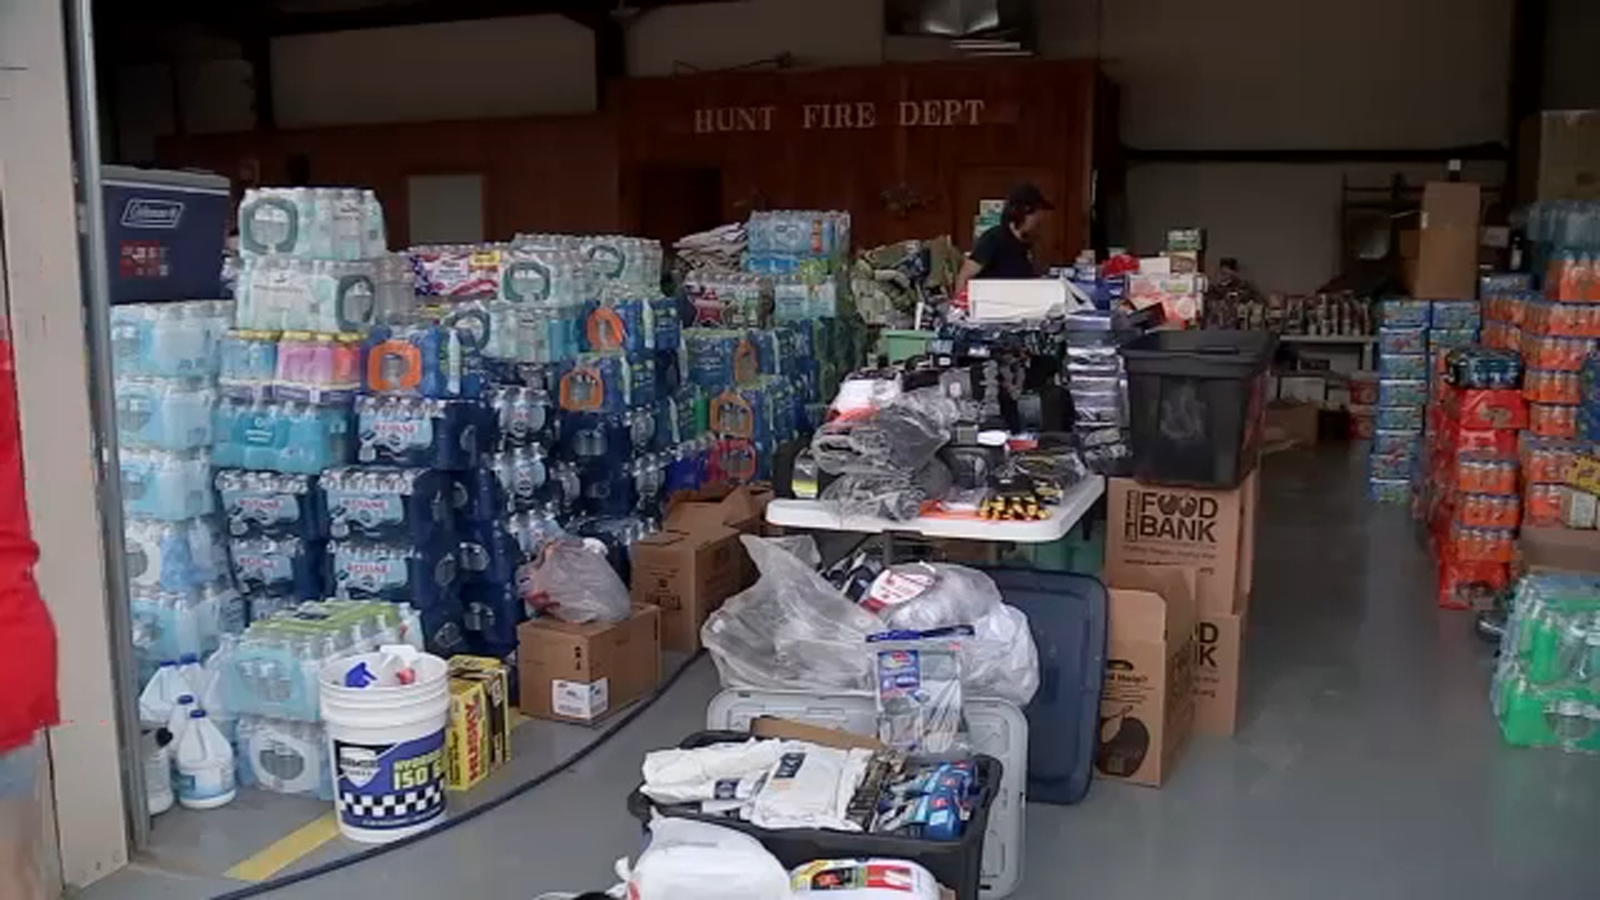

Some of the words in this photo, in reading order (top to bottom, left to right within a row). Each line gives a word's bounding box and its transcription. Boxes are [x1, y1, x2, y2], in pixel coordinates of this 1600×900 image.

[694, 106, 776, 133] HUNT
[803, 103, 876, 129] FIRE
[899, 100, 985, 126] DEPT
[1141, 492, 1219, 519] FOOD
[1140, 514, 1217, 543] BANK
[393, 765, 428, 791] ISO
